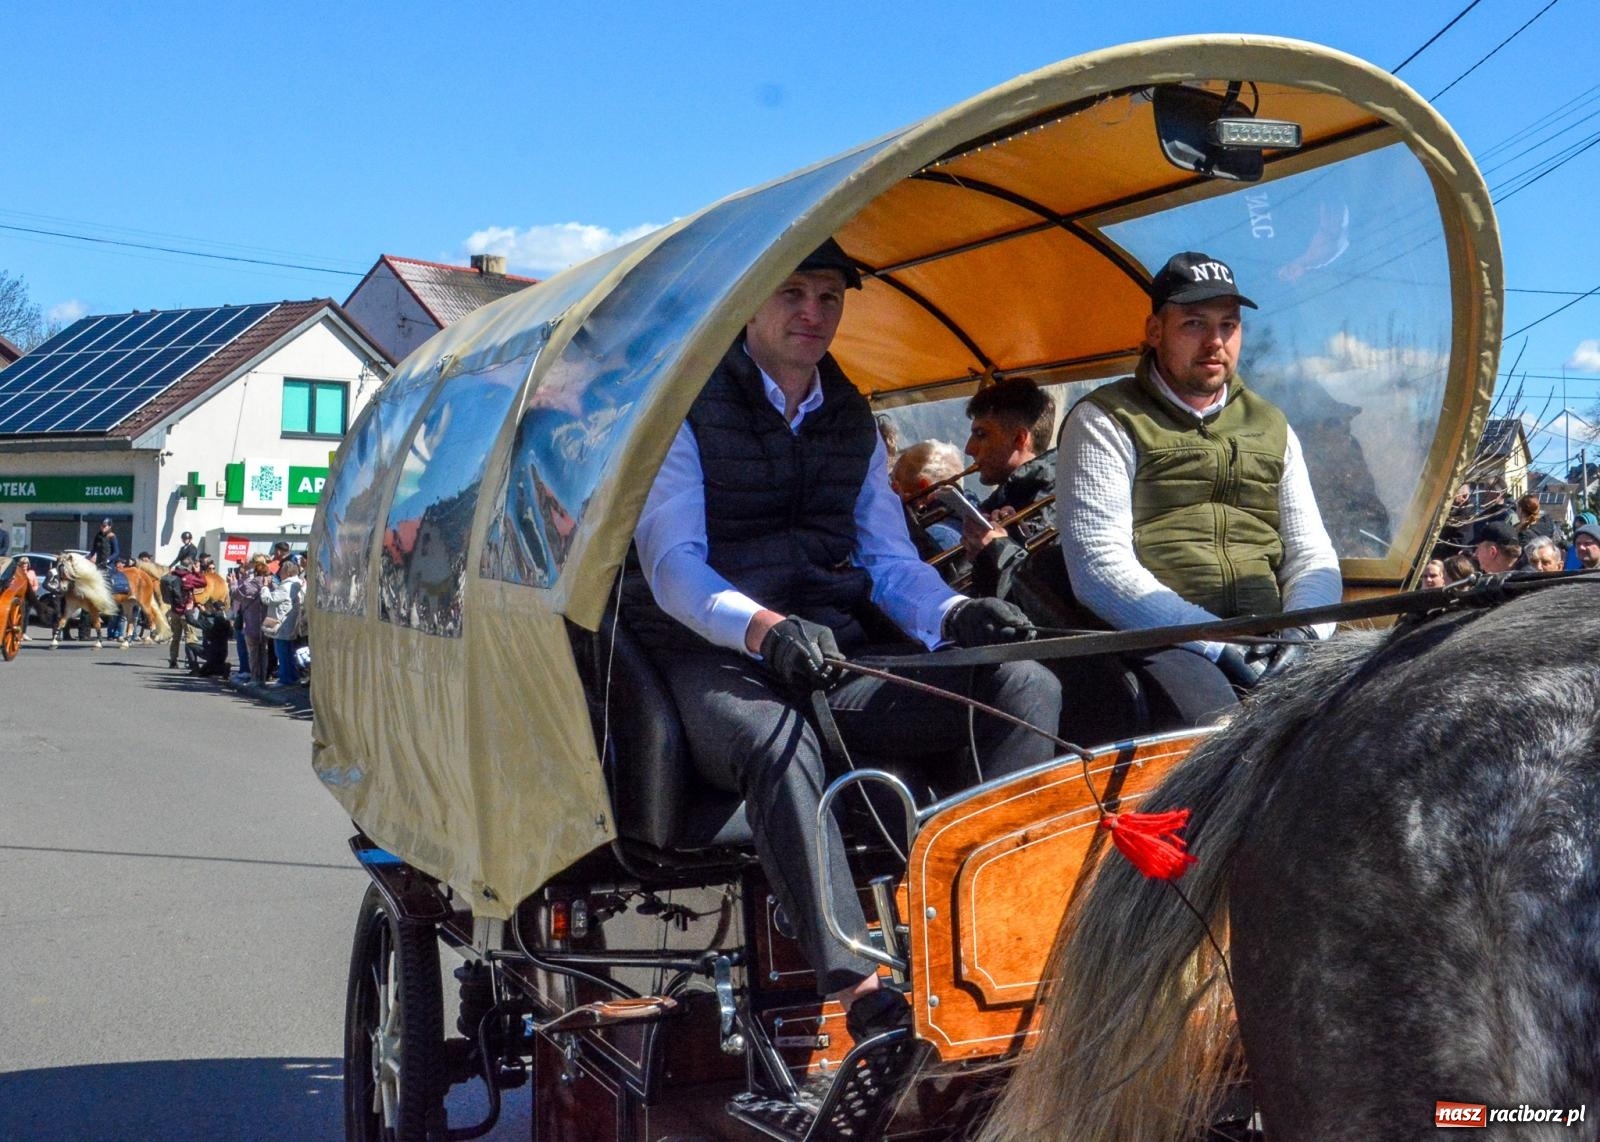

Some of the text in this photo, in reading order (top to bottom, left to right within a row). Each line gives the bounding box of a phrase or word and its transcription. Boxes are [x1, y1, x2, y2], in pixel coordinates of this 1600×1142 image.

[1190, 262, 1233, 284] NYC
[0, 482, 123, 496] TEKA ZIELONA
